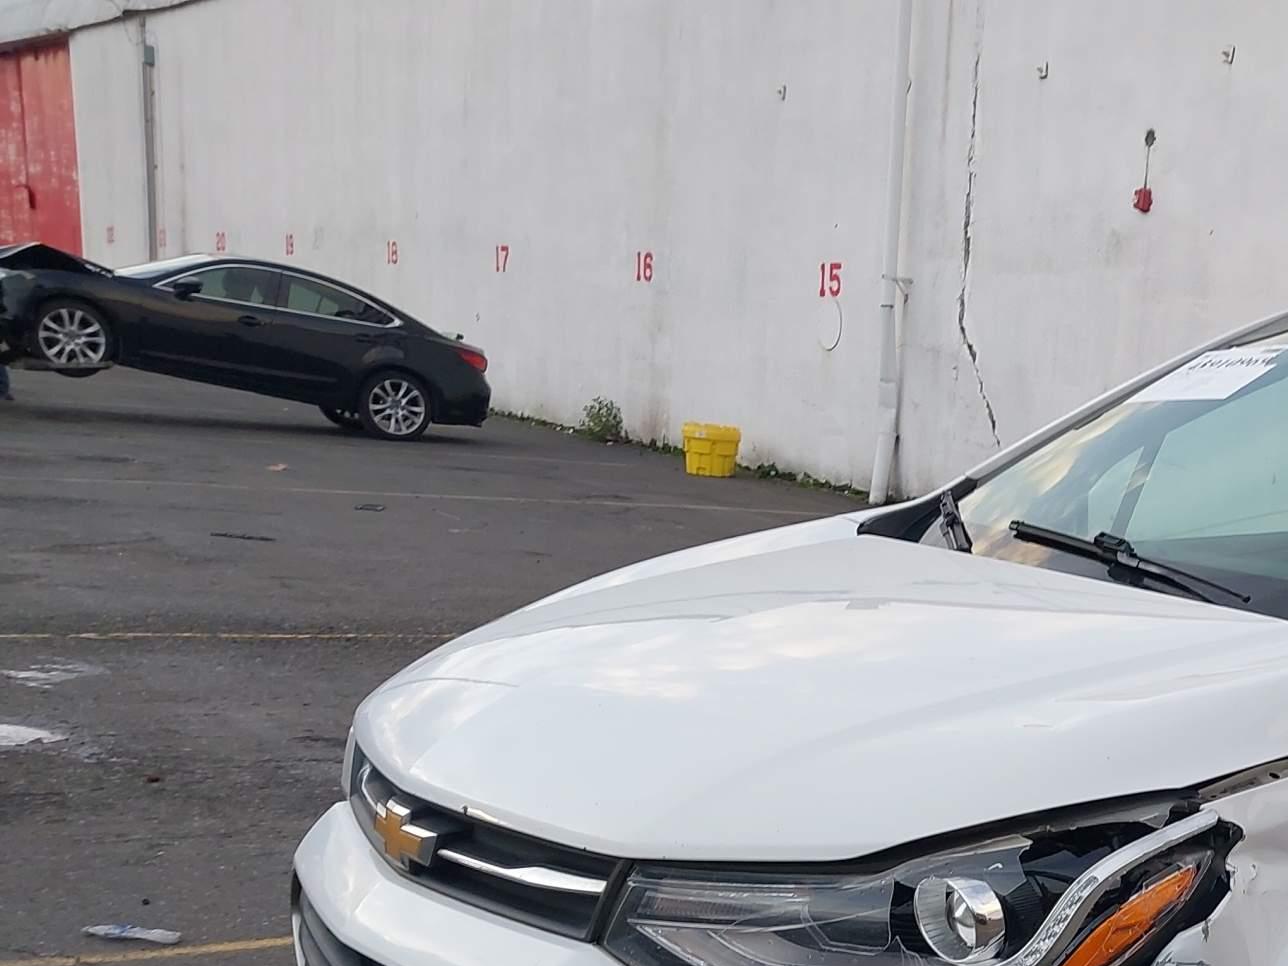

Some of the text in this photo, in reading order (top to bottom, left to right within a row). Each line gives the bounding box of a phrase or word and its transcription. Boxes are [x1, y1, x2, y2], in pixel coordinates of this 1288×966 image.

[386, 240, 399, 265] 18
[495, 244, 510, 273] 17
[635, 251, 654, 282] 16
[818, 262, 843, 298] 15
